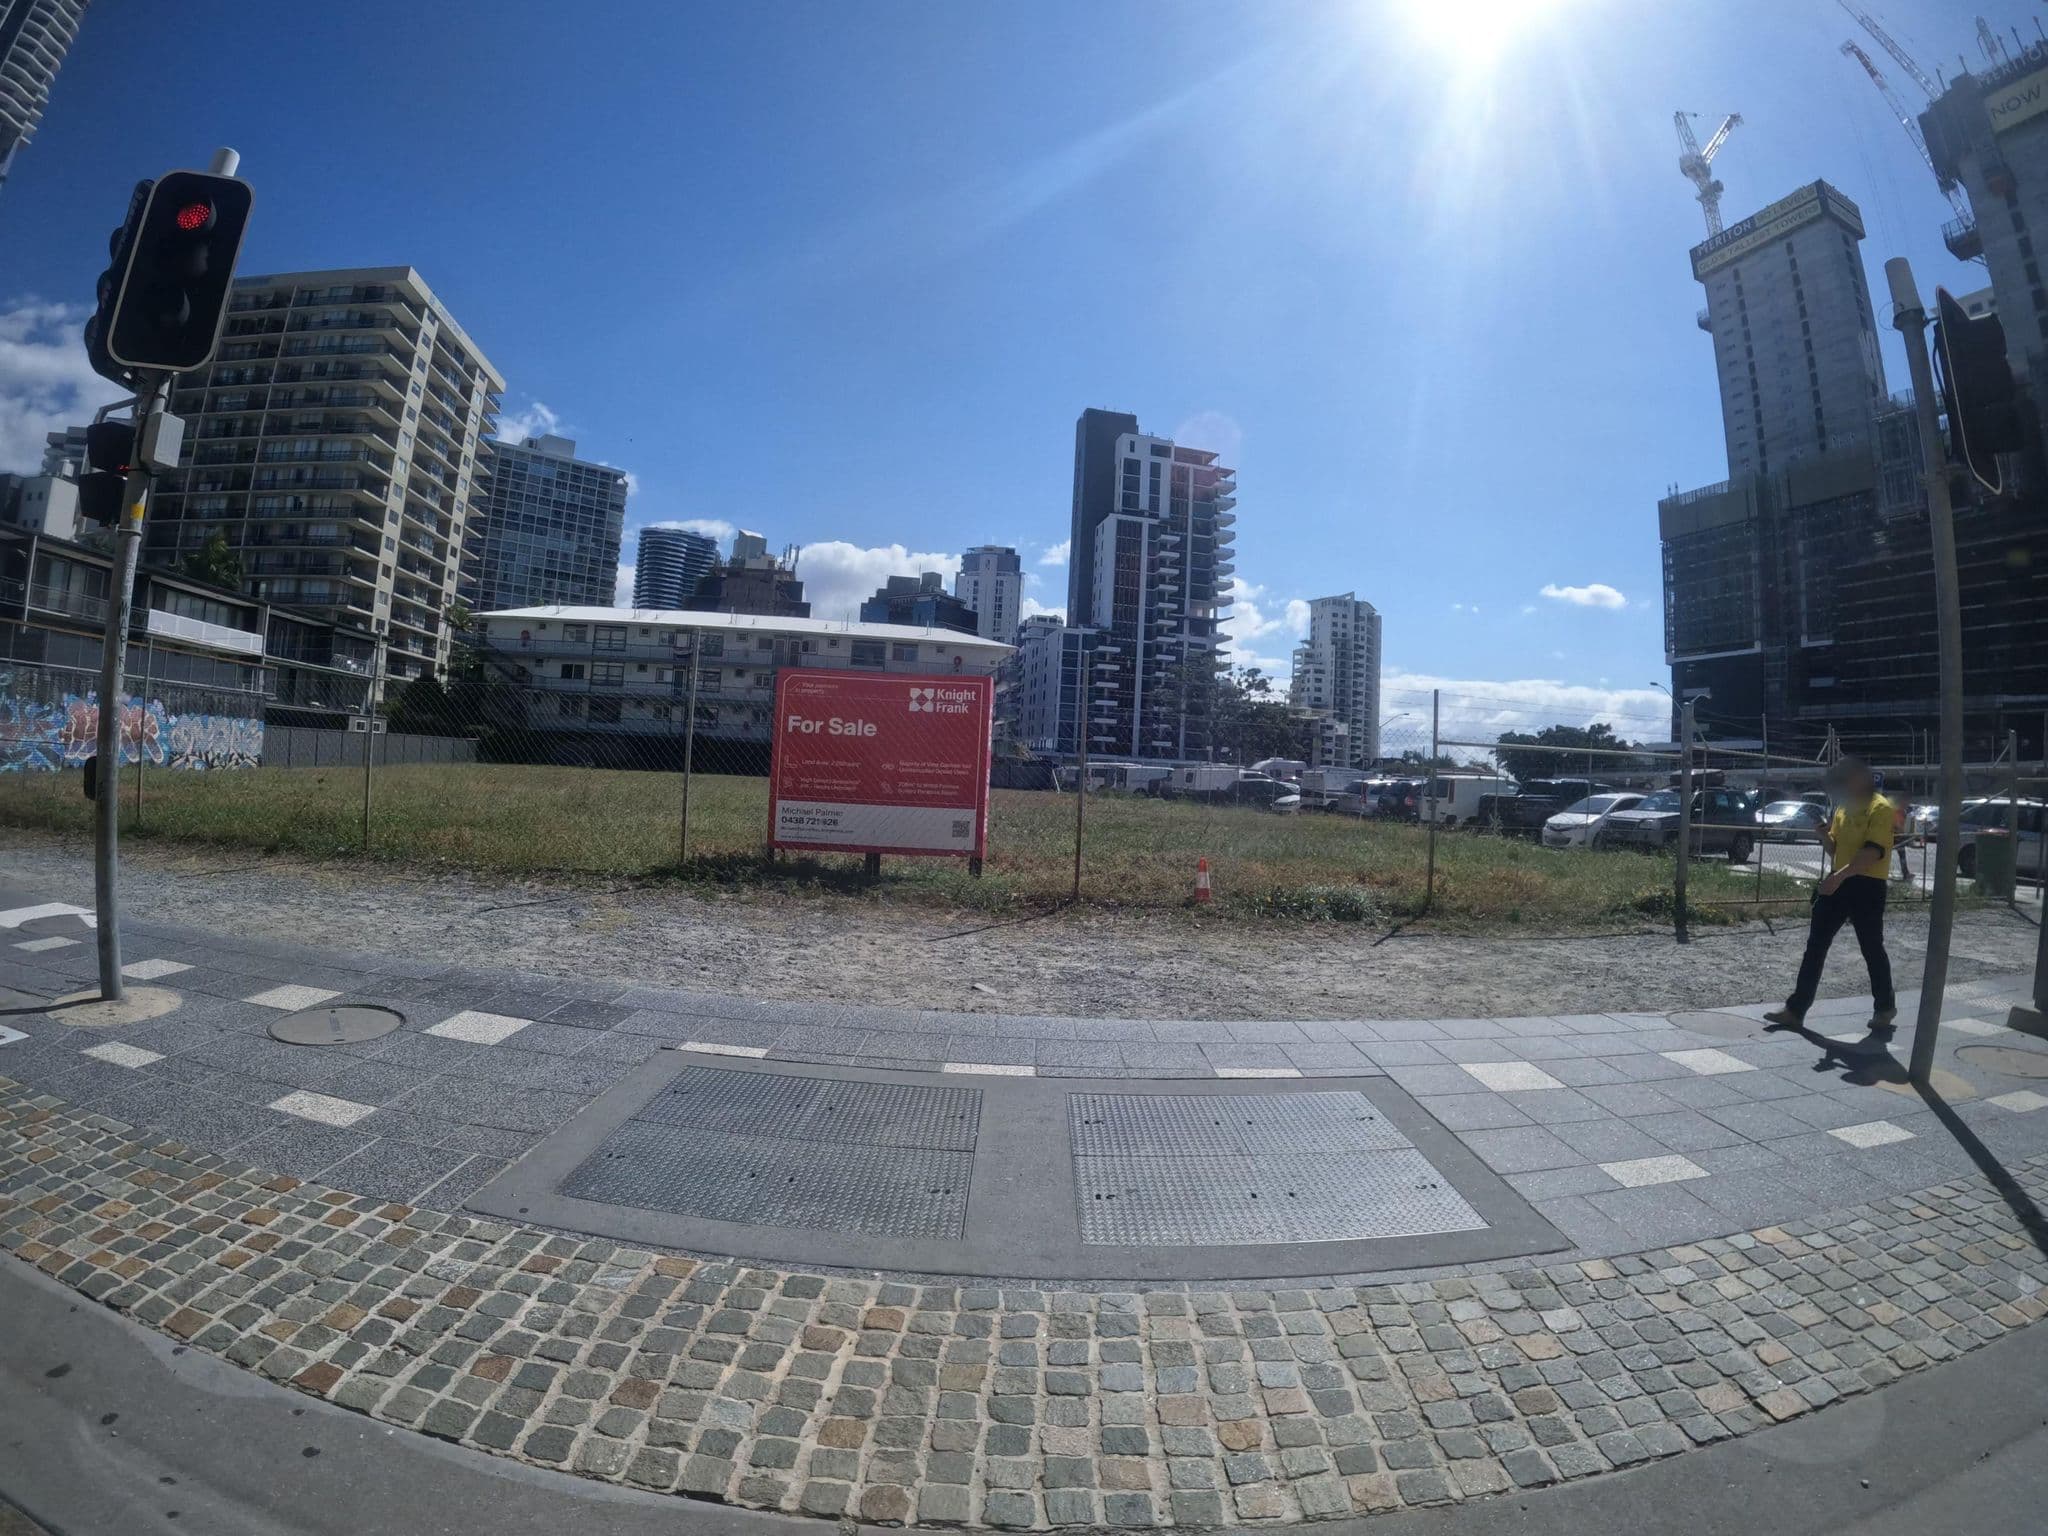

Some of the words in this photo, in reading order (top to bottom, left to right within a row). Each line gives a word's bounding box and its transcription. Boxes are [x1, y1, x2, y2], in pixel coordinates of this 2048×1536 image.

[1990, 83, 2041, 120] NOW
[1696, 220, 1752, 257] MERITON
[937, 688, 977, 703] Knight
[936, 702, 969, 714] Frank
[788, 715, 825, 734] For
[828, 717, 877, 737] Sale
[782, 807, 814, 816] Michael
